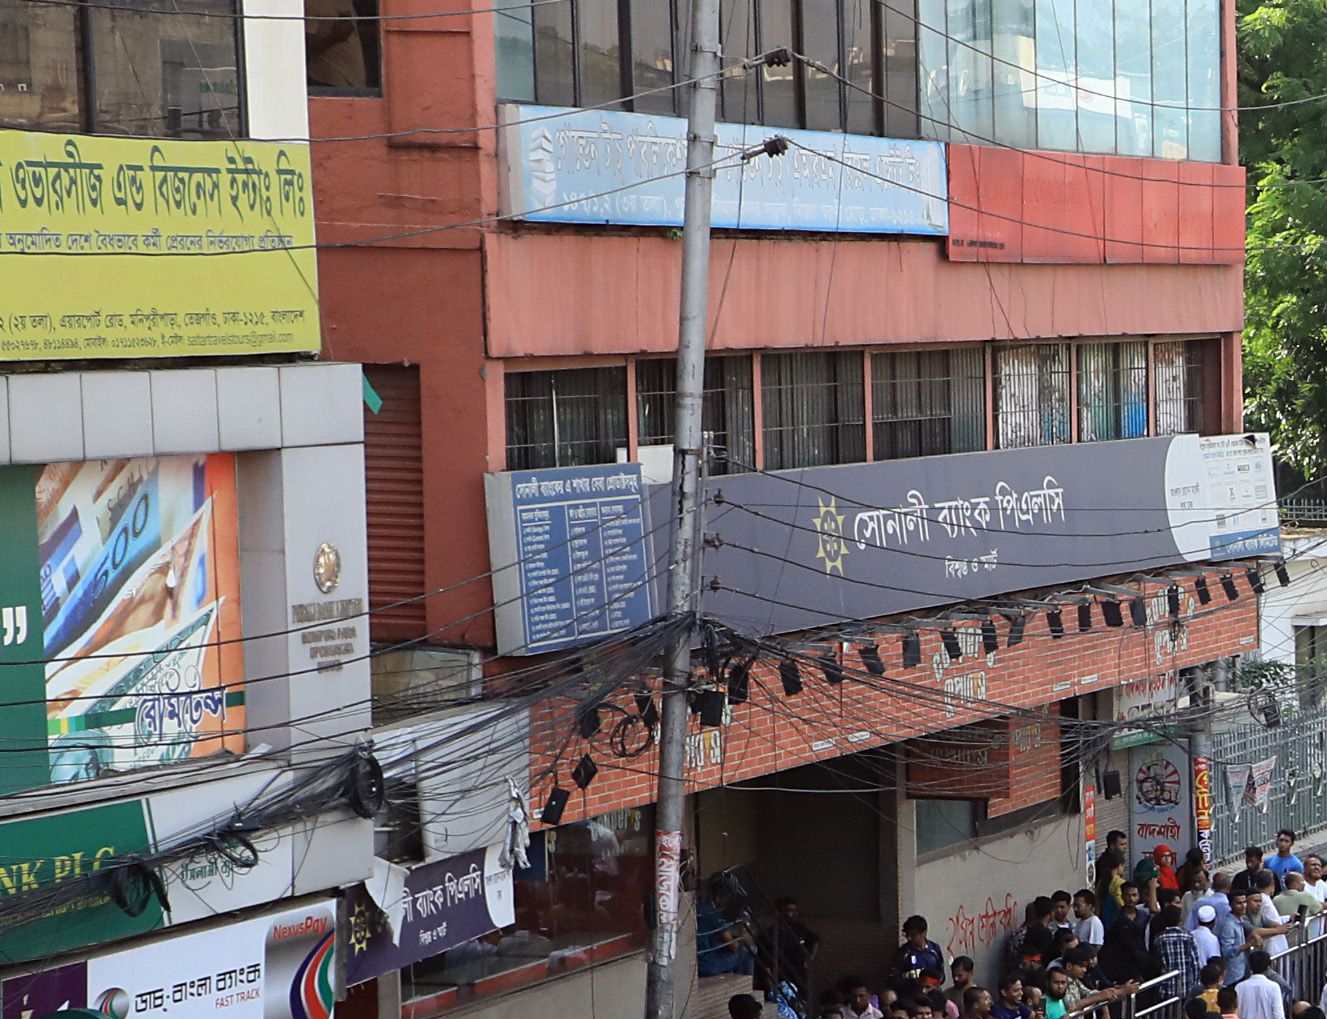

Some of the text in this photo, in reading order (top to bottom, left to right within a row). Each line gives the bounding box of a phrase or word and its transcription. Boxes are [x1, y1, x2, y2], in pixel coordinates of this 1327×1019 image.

[112, 164, 144, 216] এন্ড
[149, 145, 221, 216] বিজনেস
[276, 150, 305, 217] লিঃ
[5, 227, 62, 252] অনুমোদিত
[854, 475, 1065, 550] সোনালী ব্যাংক পিএলসি
[273, 916, 327, 940] NexusPay
[134, 962, 262, 1013] ডাচ্-বাংলা ব্যাংক
[215, 988, 261, 1010] FAST TRACK
